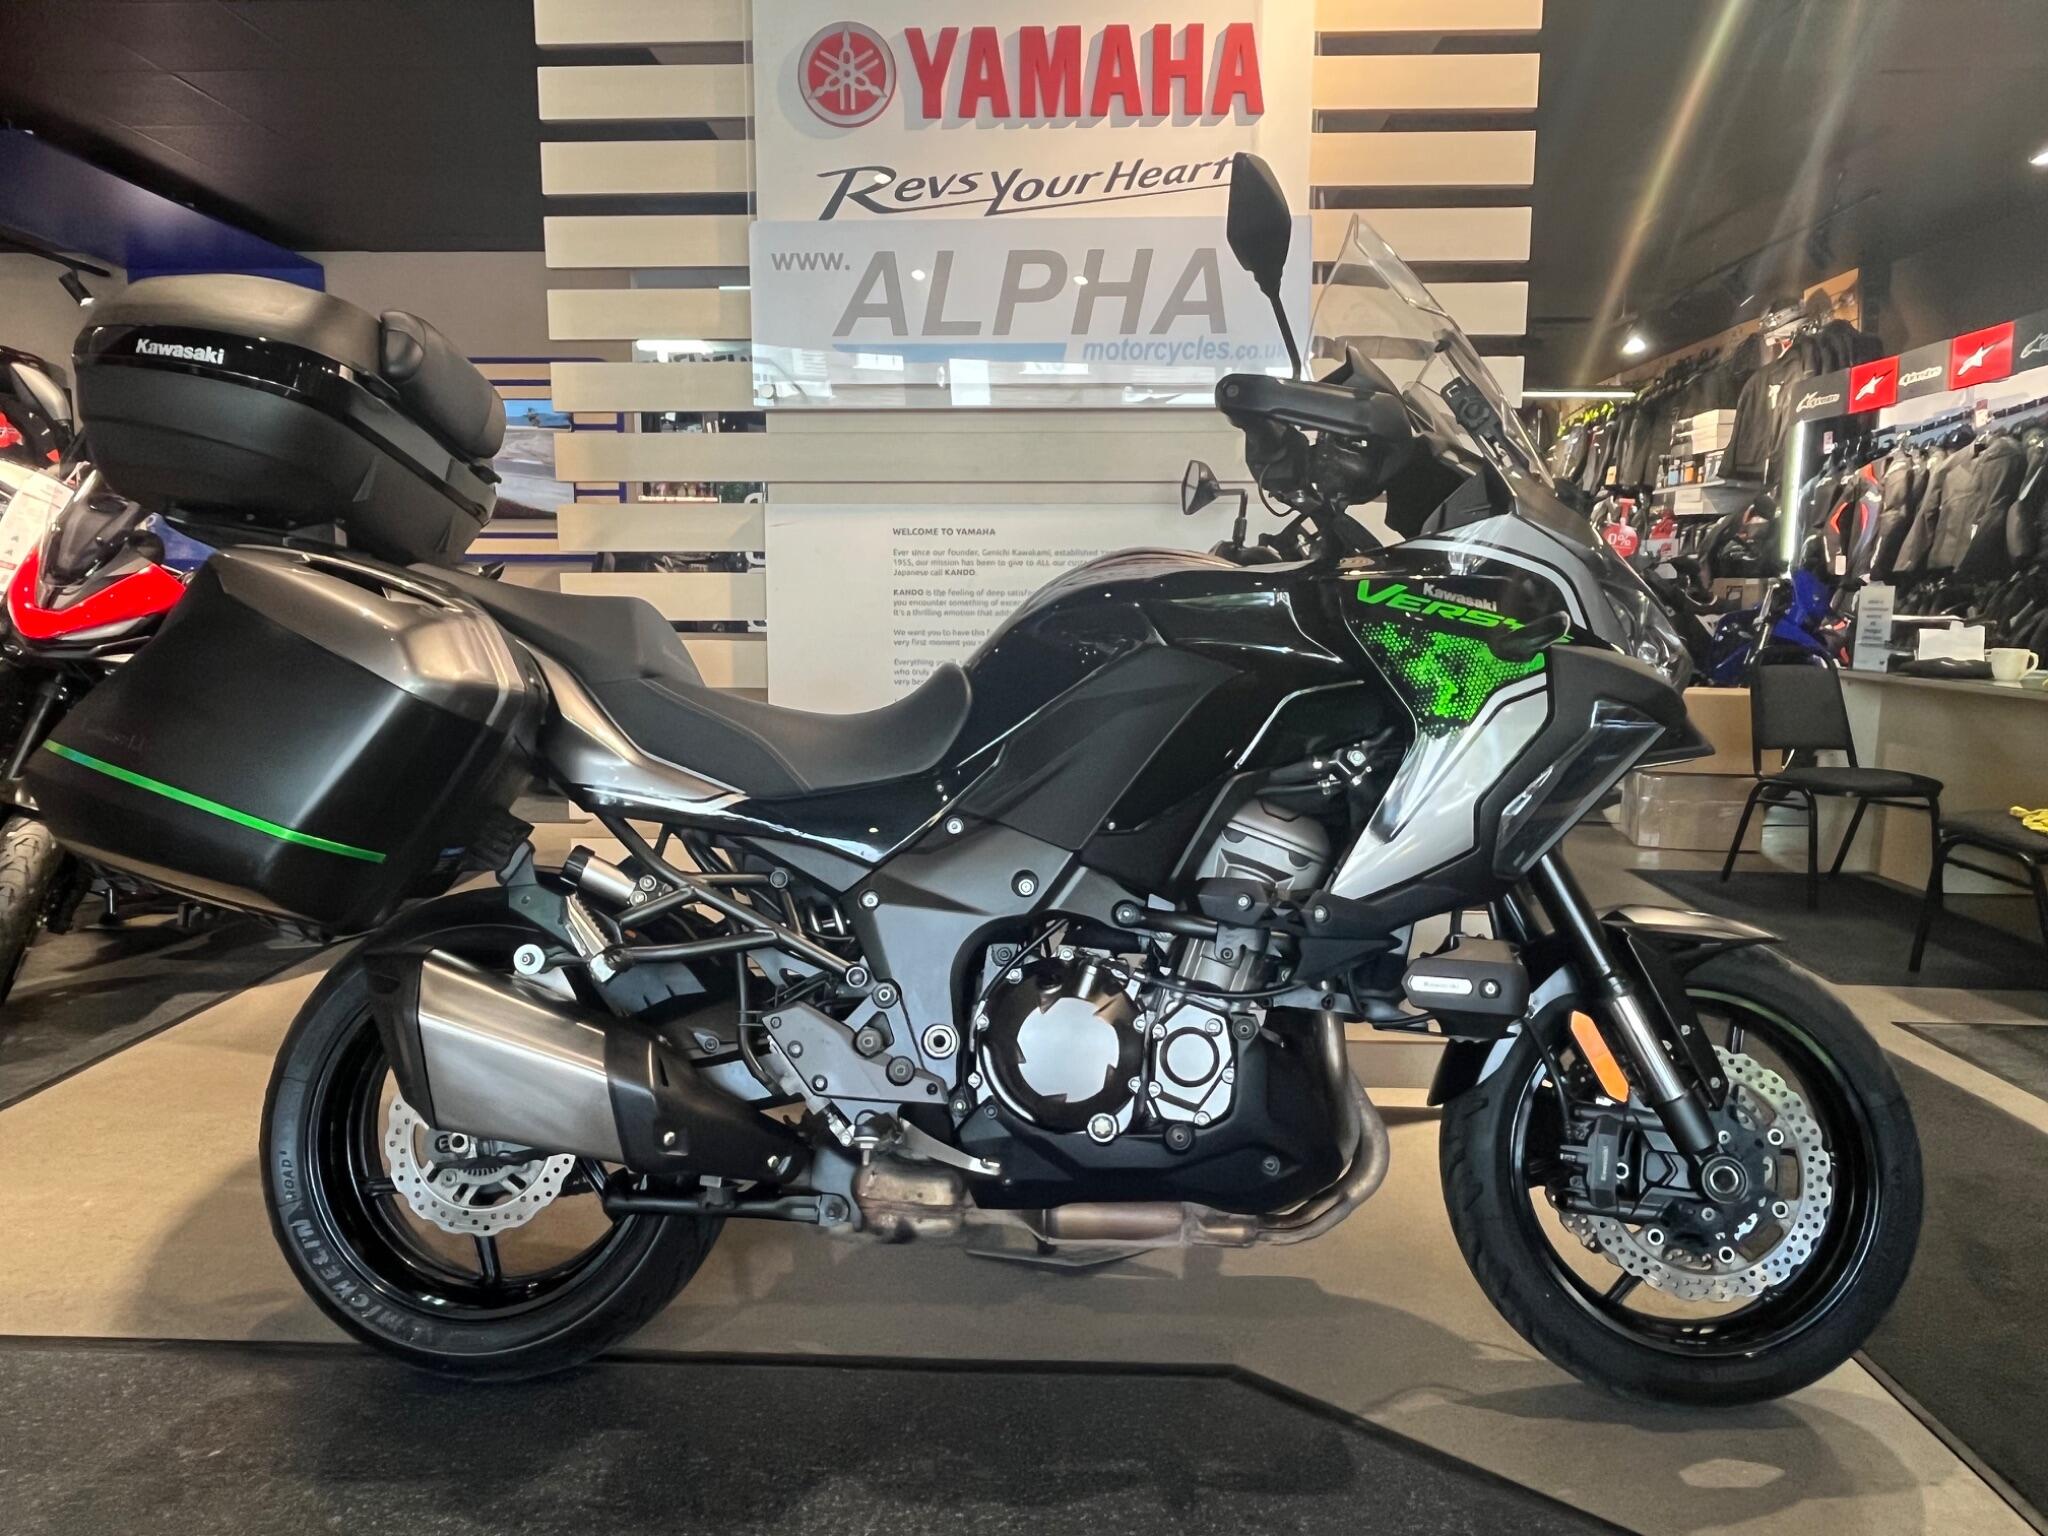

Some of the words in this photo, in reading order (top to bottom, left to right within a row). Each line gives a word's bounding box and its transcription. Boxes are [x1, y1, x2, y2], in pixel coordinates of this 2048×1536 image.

[904, 22, 1264, 119] YAMAHA
[817, 165, 985, 221] Revs
[984, 166, 1103, 217] Your
[1104, 155, 1232, 194] Heart
[771, 251, 851, 272] www.
[832, 247, 1228, 338] ALPHA
[136, 338, 225, 365] Kawasaki
[893, 528, 939, 536] WELCOME
[941, 528, 953, 536] TO
[956, 528, 996, 536] YAMAHA
[1607, 533, 1631, 546] 0%
[1423, 583, 1497, 612] Kawasaki
